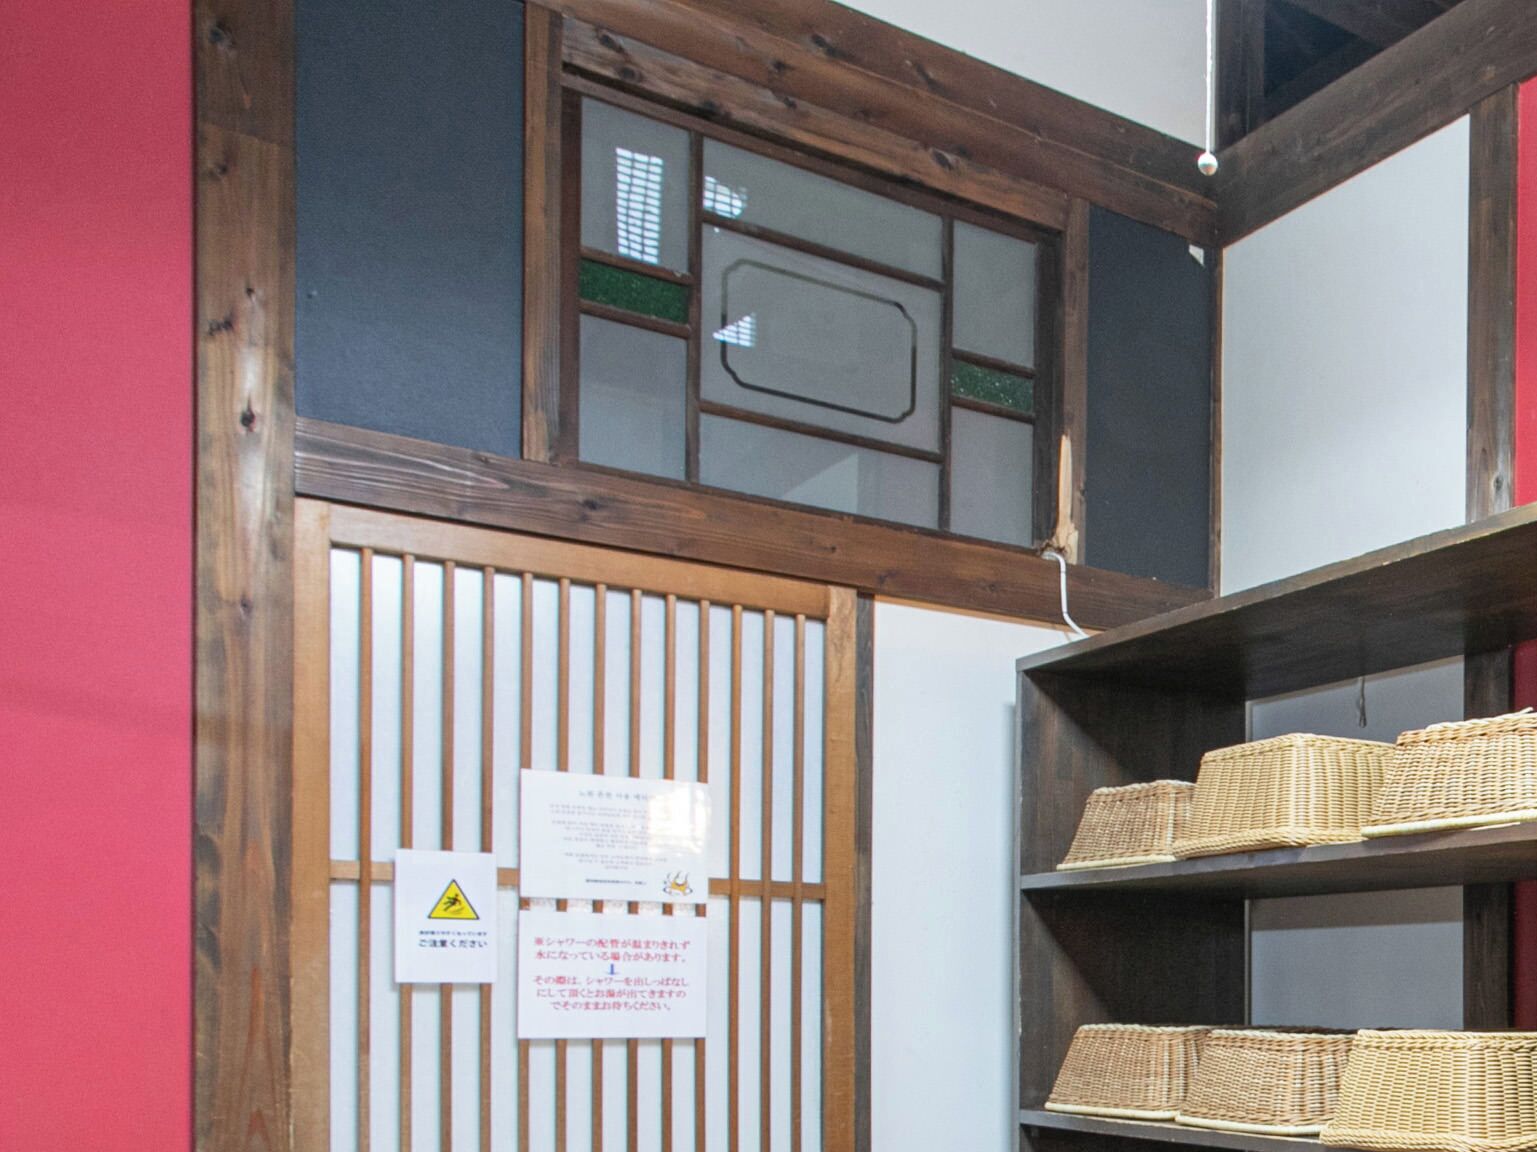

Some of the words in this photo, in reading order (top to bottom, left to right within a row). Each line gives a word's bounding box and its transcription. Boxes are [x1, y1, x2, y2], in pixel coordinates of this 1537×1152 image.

[418, 938, 488, 948] ご注意ください
[535, 950, 687, 962] 水になっている場合があります。
